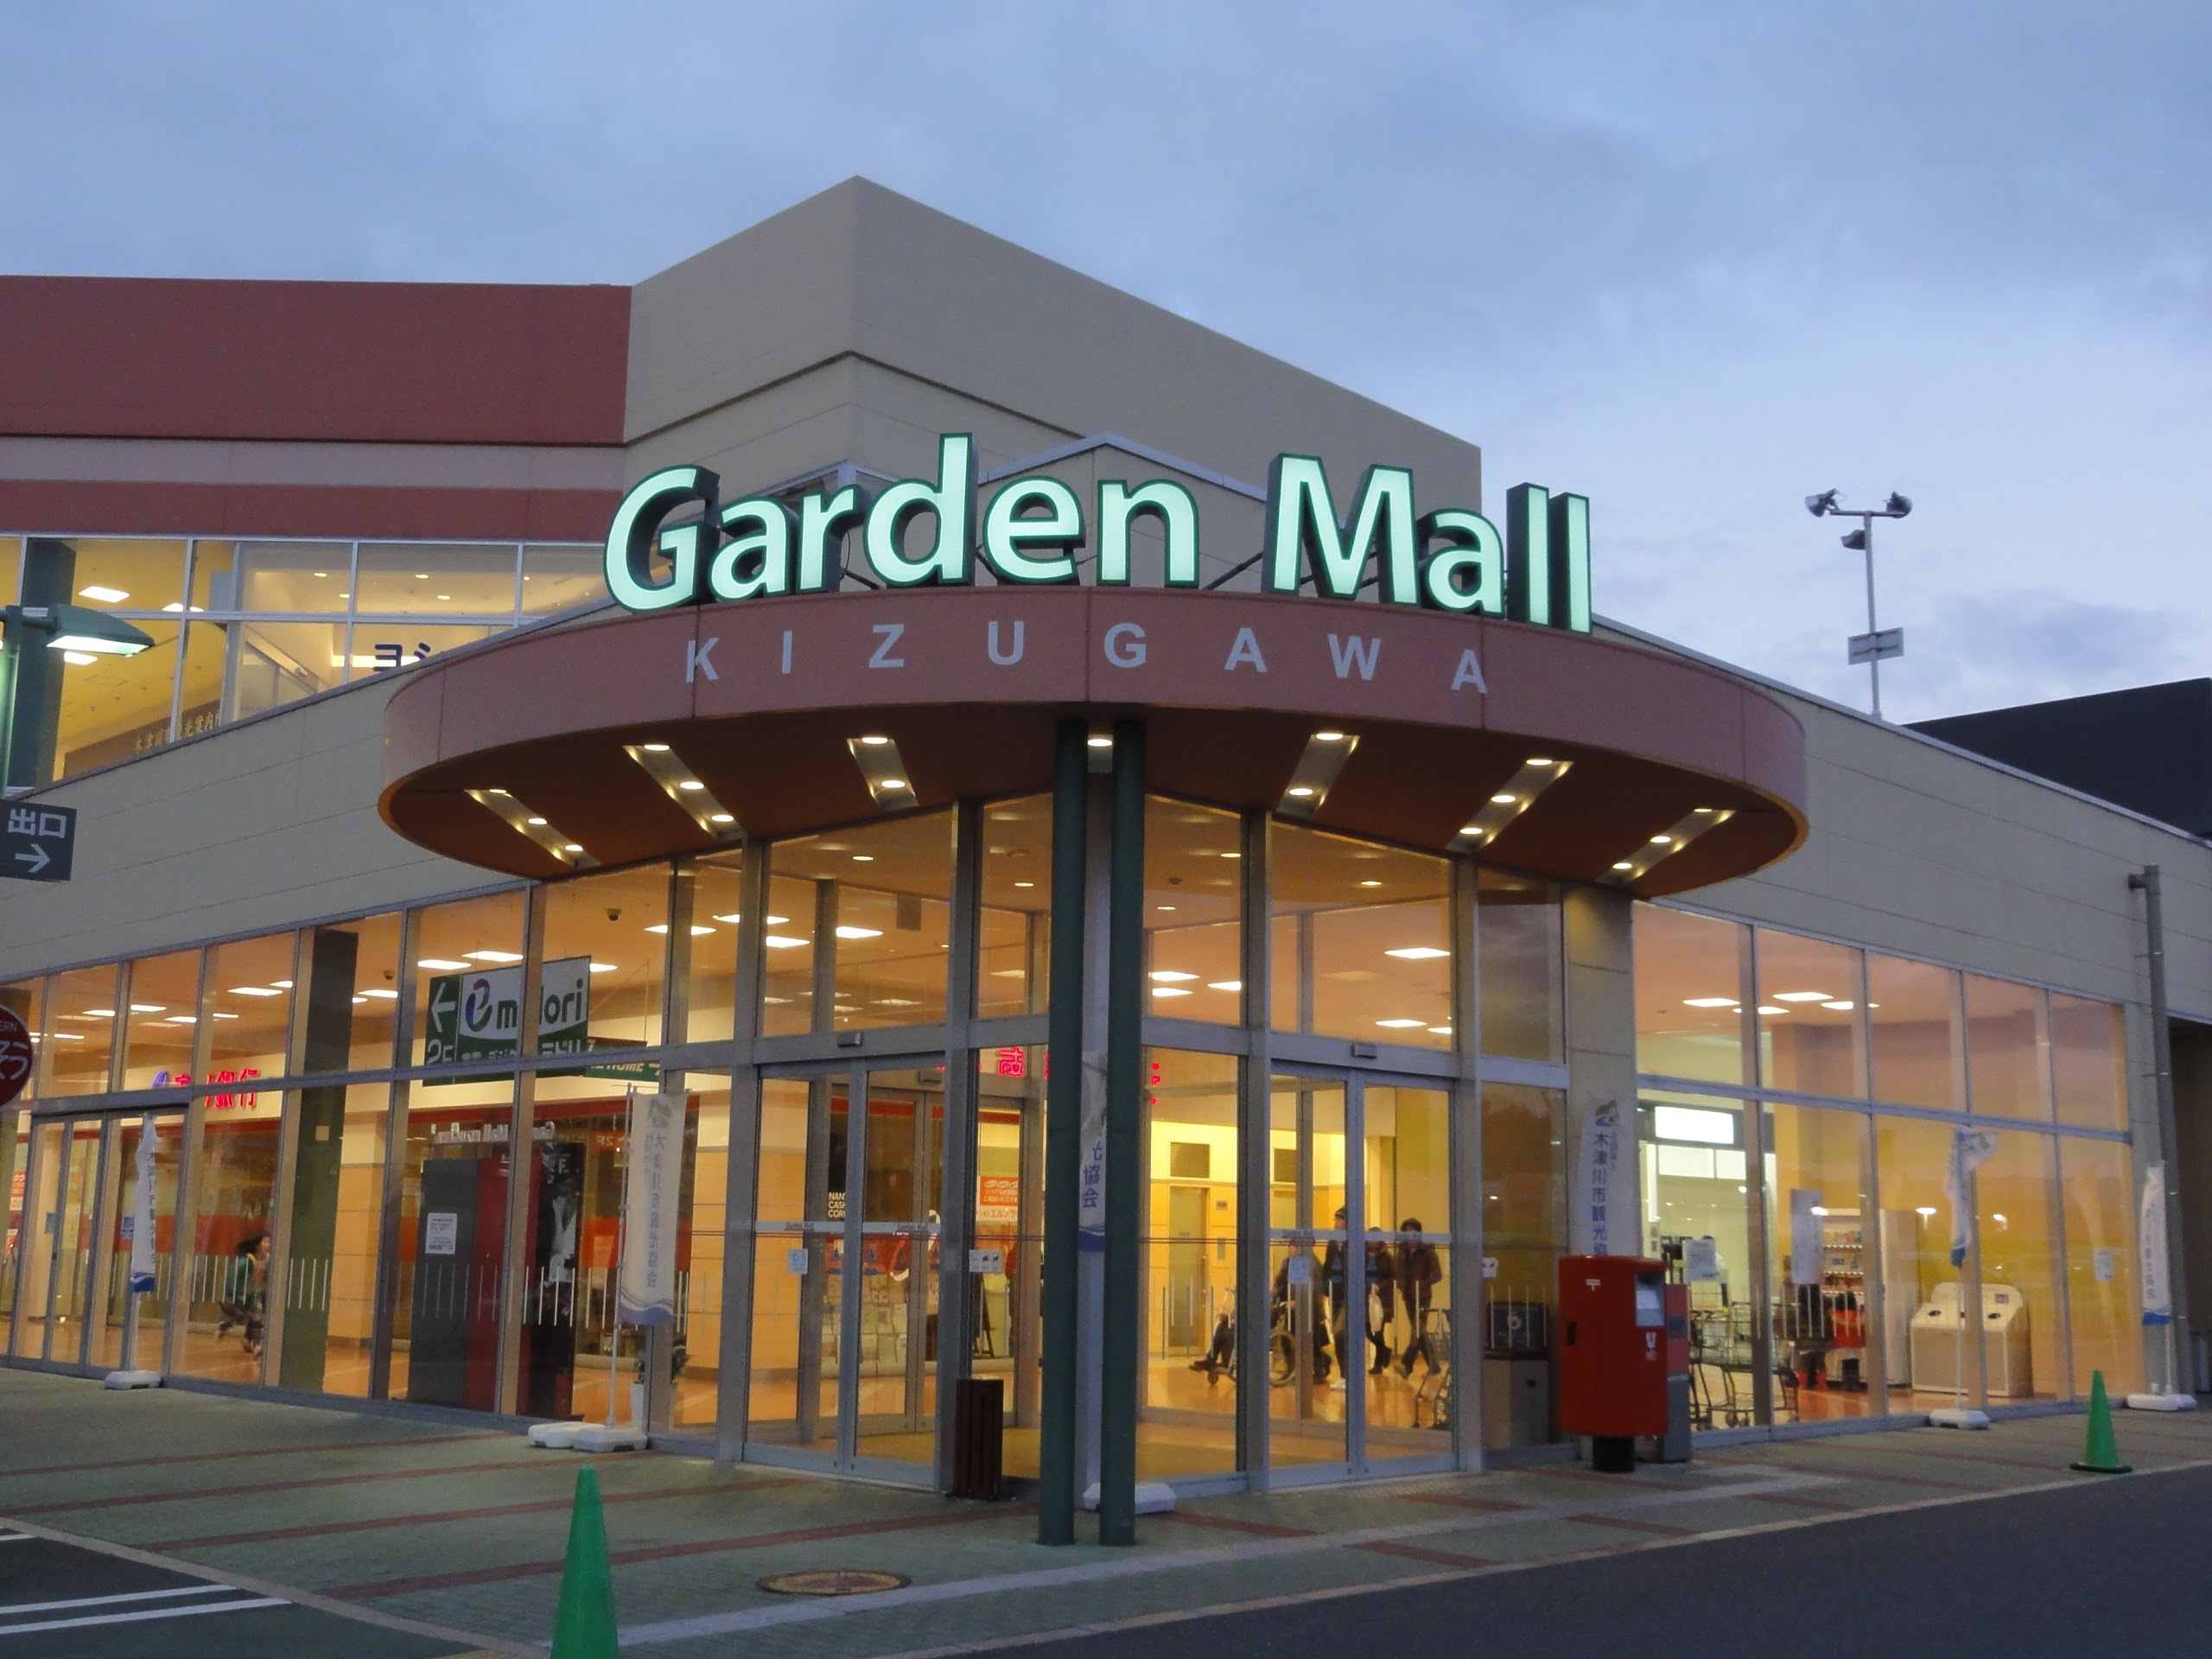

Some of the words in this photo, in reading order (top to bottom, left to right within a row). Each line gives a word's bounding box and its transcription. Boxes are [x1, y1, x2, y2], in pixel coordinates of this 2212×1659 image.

[604, 432, 1199, 613] Garden
[1263, 451, 1592, 636] Mall
[686, 620, 1487, 695] KIZUGAWA
[8, 808, 67, 839] 出口
[829, 1192, 846, 1201] NAN
